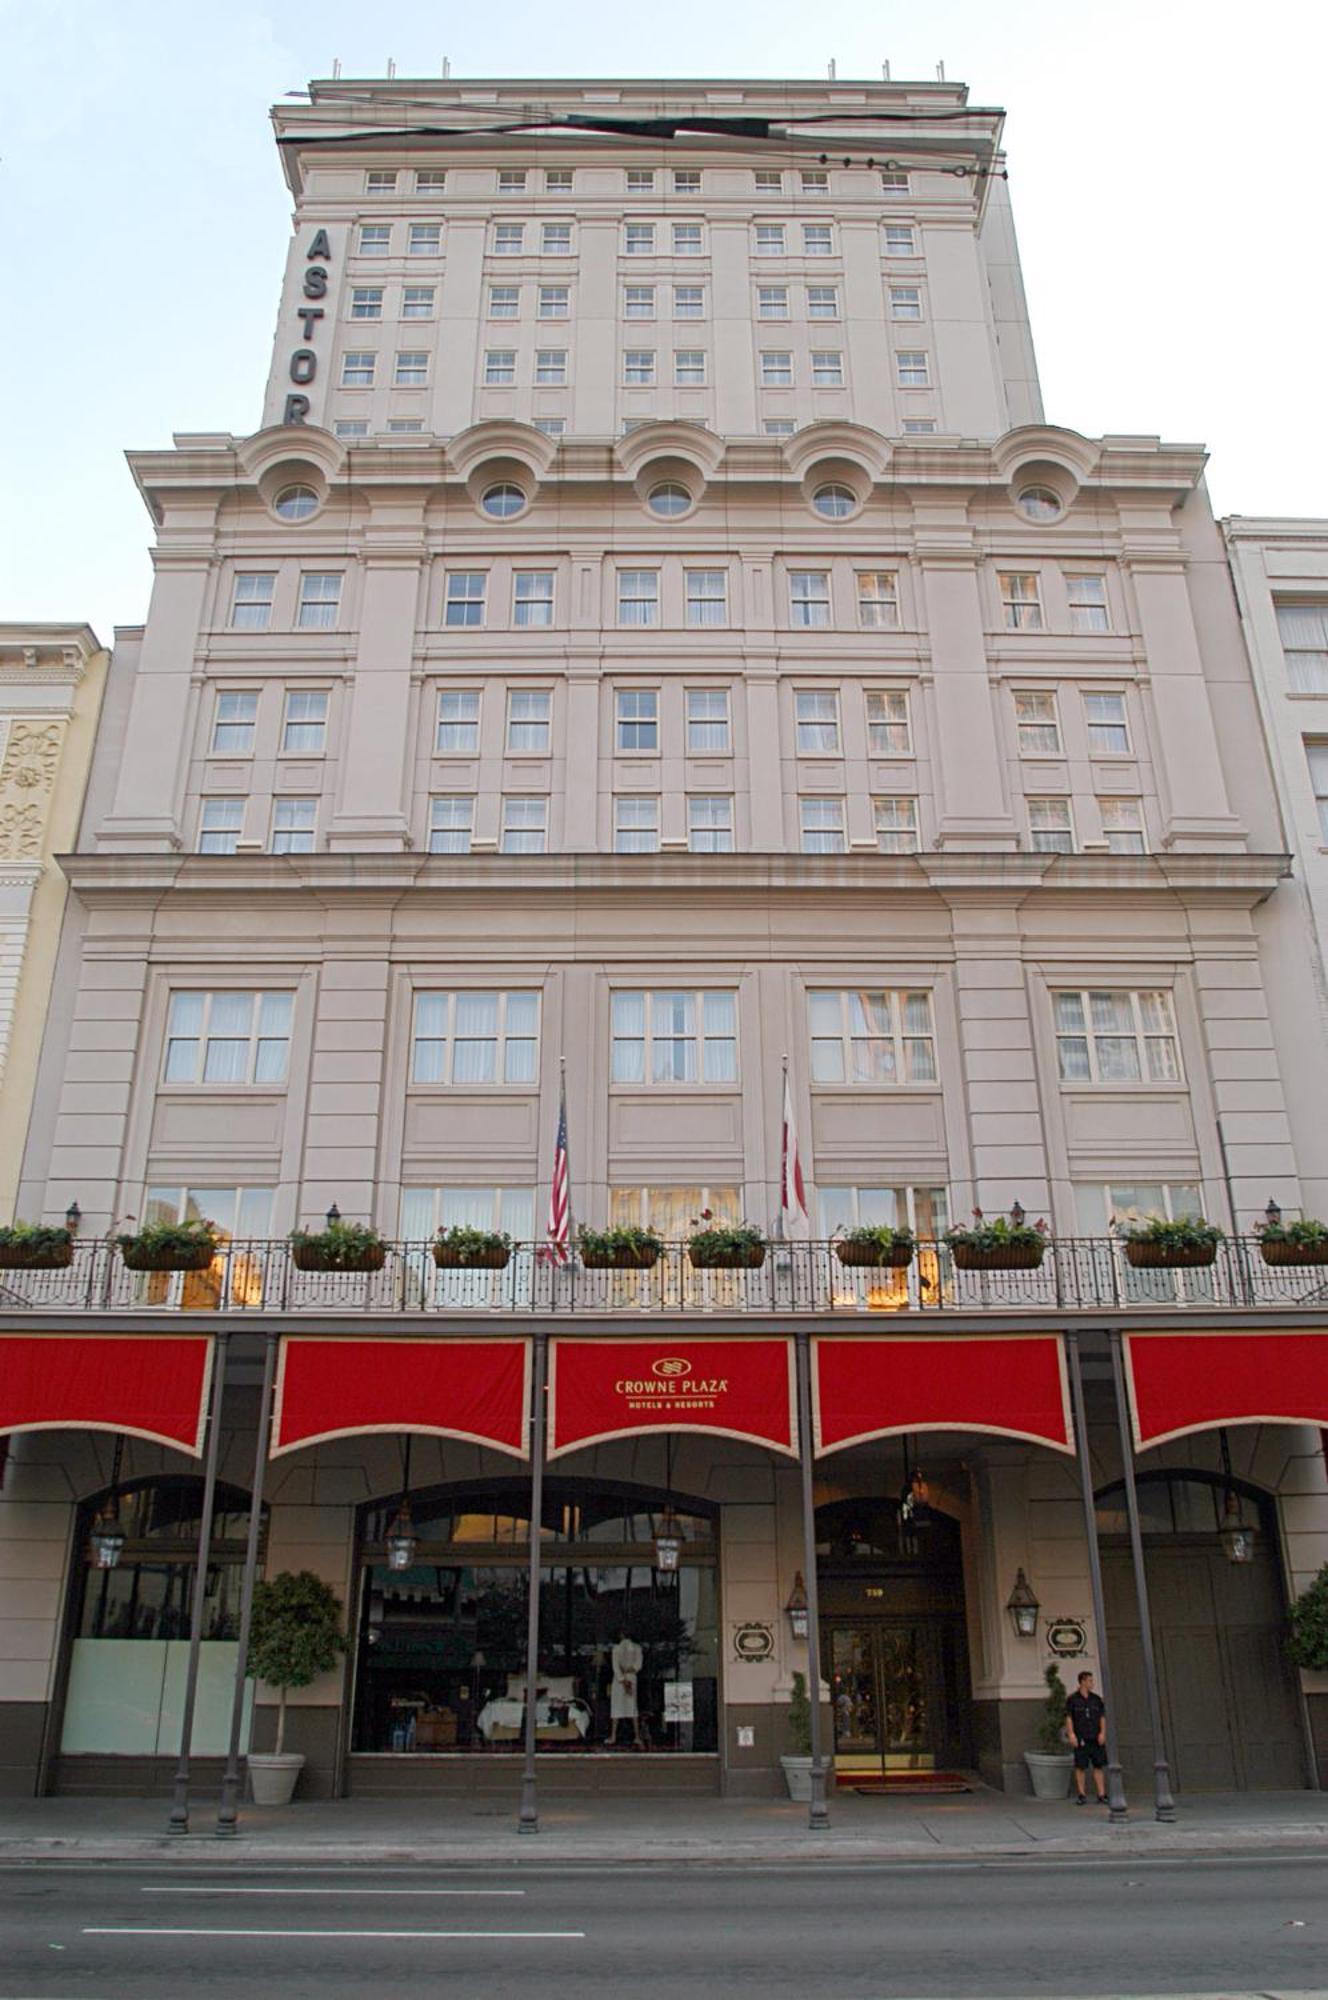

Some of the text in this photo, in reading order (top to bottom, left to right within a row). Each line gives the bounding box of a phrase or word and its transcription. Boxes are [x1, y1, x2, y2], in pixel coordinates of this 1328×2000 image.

[283, 228, 332, 426] ASTOR
[615, 1379, 728, 1394] CROWNE PLAZA
[628, 1401, 663, 1409] HOTELS
[674, 1401, 715, 1409] RESORTS
